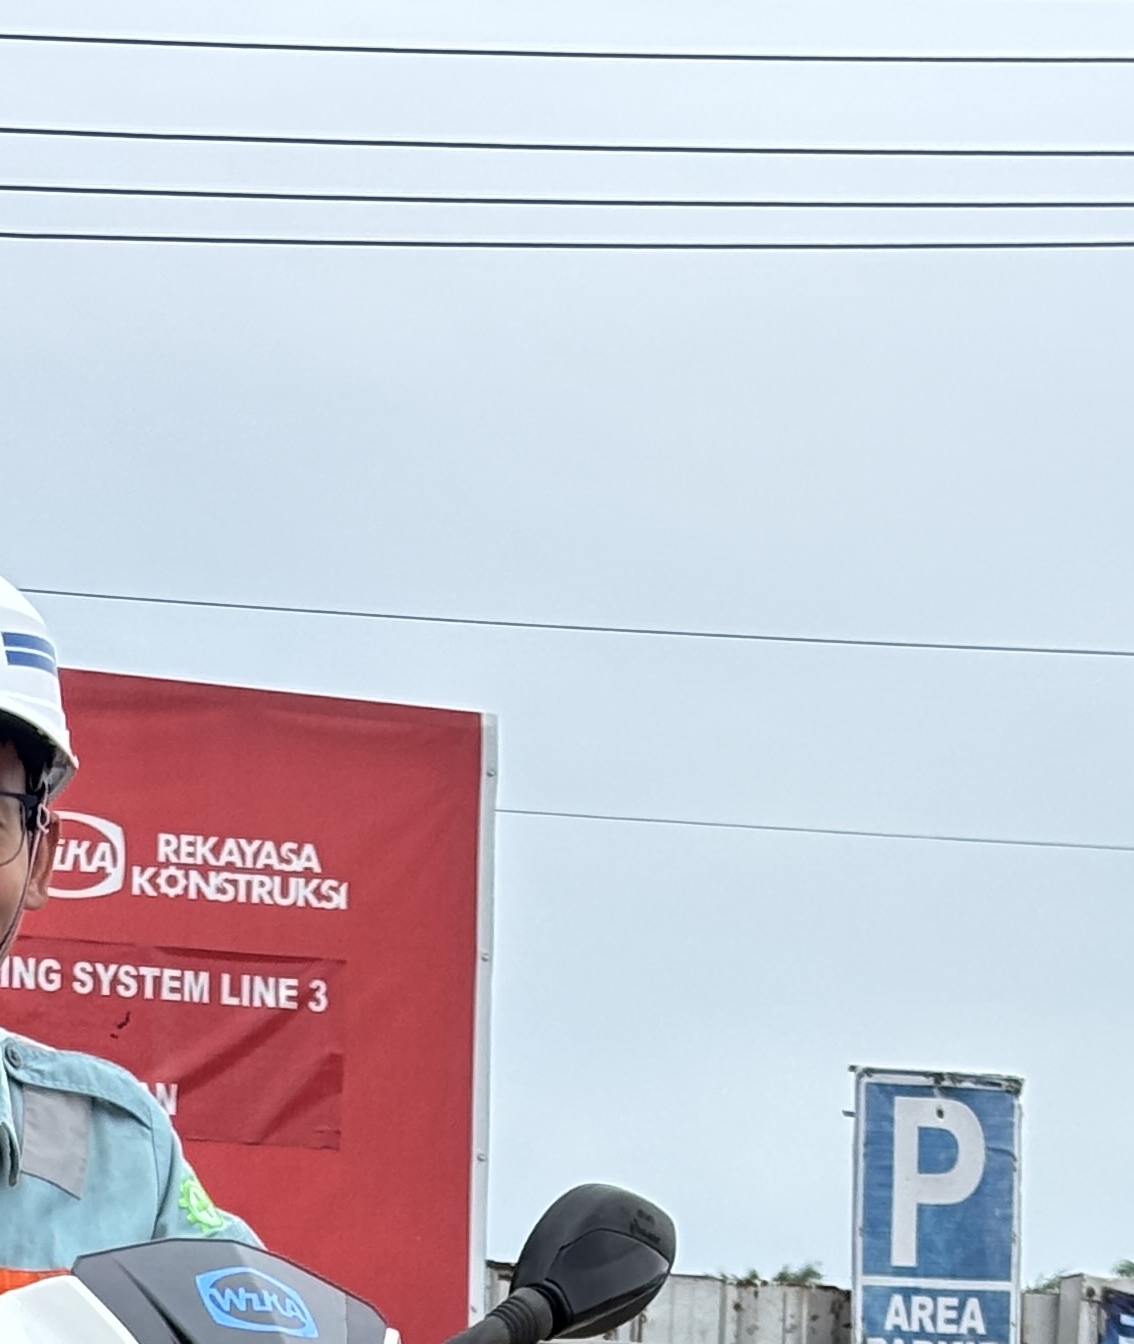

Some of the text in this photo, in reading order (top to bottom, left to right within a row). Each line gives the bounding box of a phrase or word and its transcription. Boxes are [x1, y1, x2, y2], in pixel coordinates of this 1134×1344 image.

[52, 838, 113, 873] iKA
[157, 832, 322, 873] REKAYASA
[131, 865, 349, 910] KONSTRUKSI
[72, 960, 210, 1004] SYSTEM
[220, 973, 299, 1010] LINE
[307, 979, 329, 1013] 3
[890, 1096, 986, 1268] P
[884, 1293, 986, 1335] AREA
